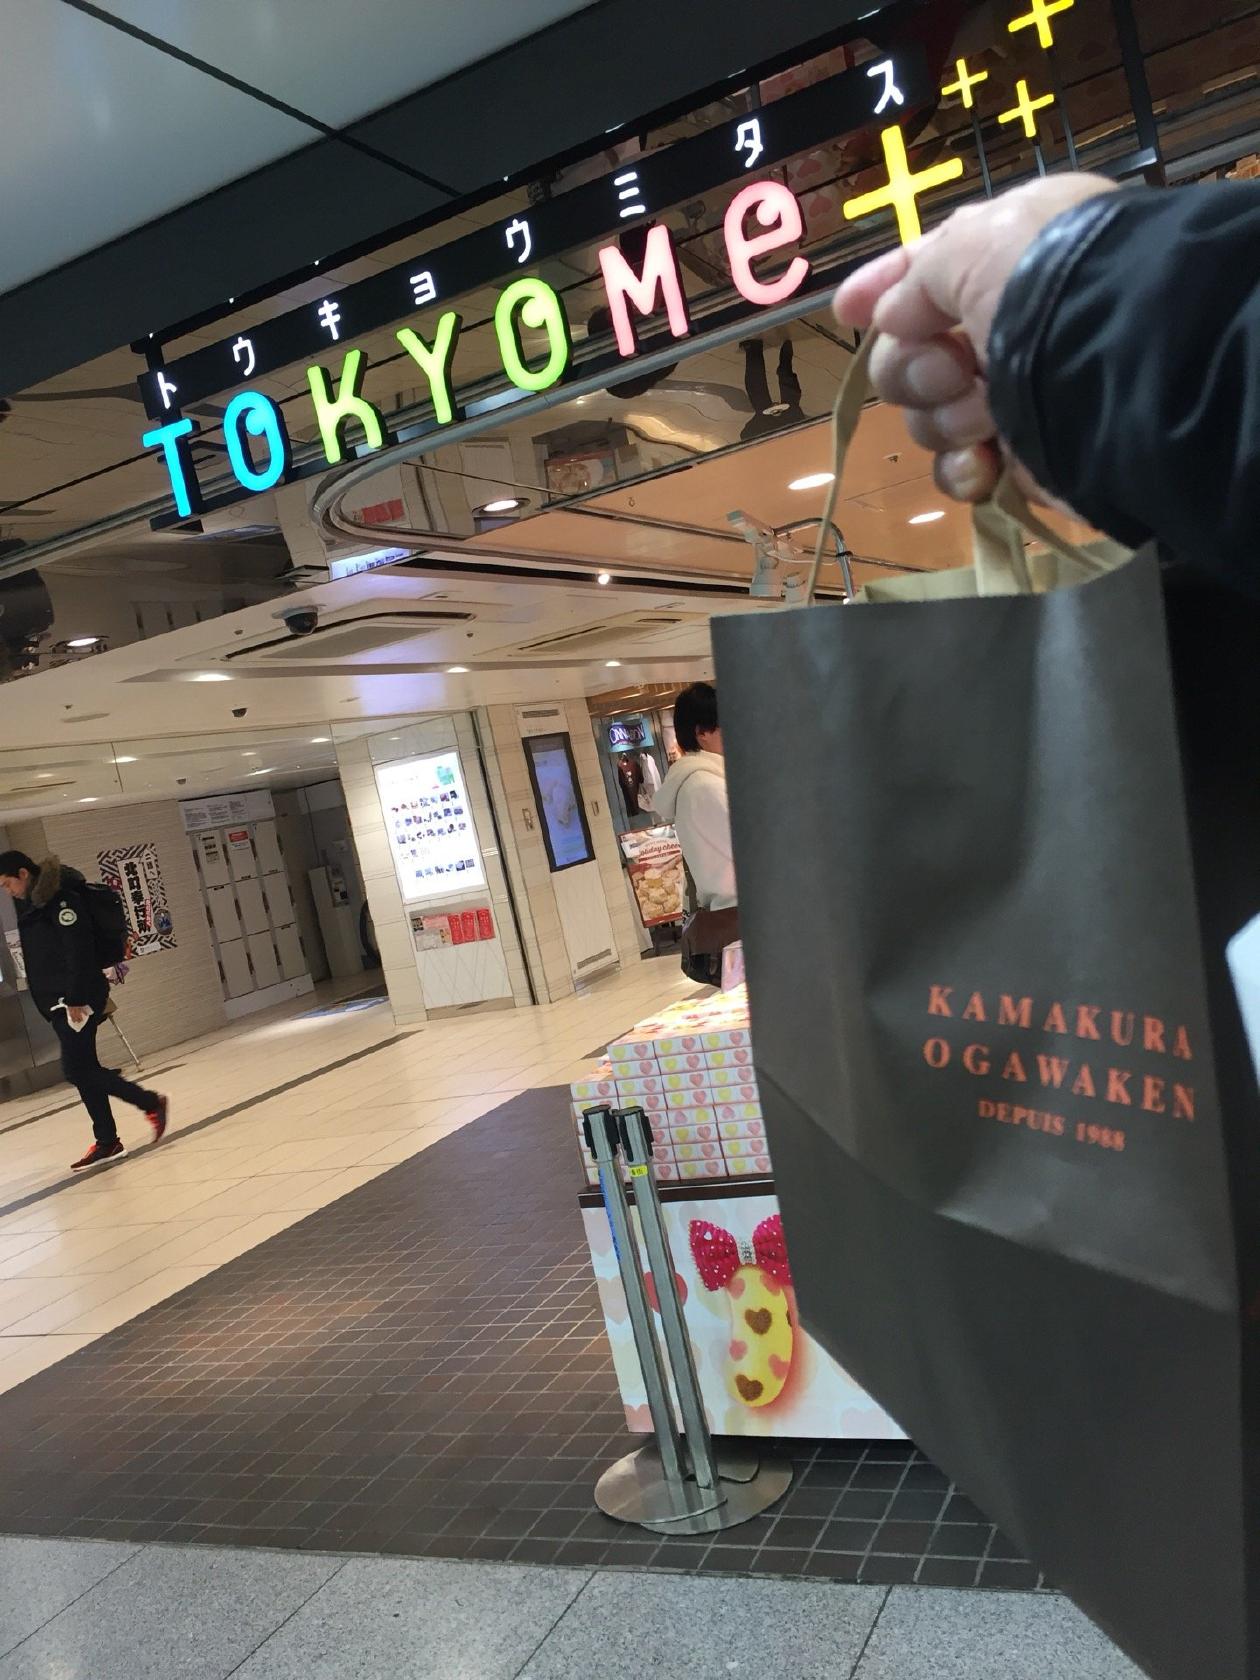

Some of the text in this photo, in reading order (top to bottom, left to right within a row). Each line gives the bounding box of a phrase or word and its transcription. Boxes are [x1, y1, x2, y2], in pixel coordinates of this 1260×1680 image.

[926, 985, 1193, 1060] KAMAKURA
[923, 1038, 1196, 1121] OGAWAKEN
[977, 1099, 1066, 1136] DEPUIS
